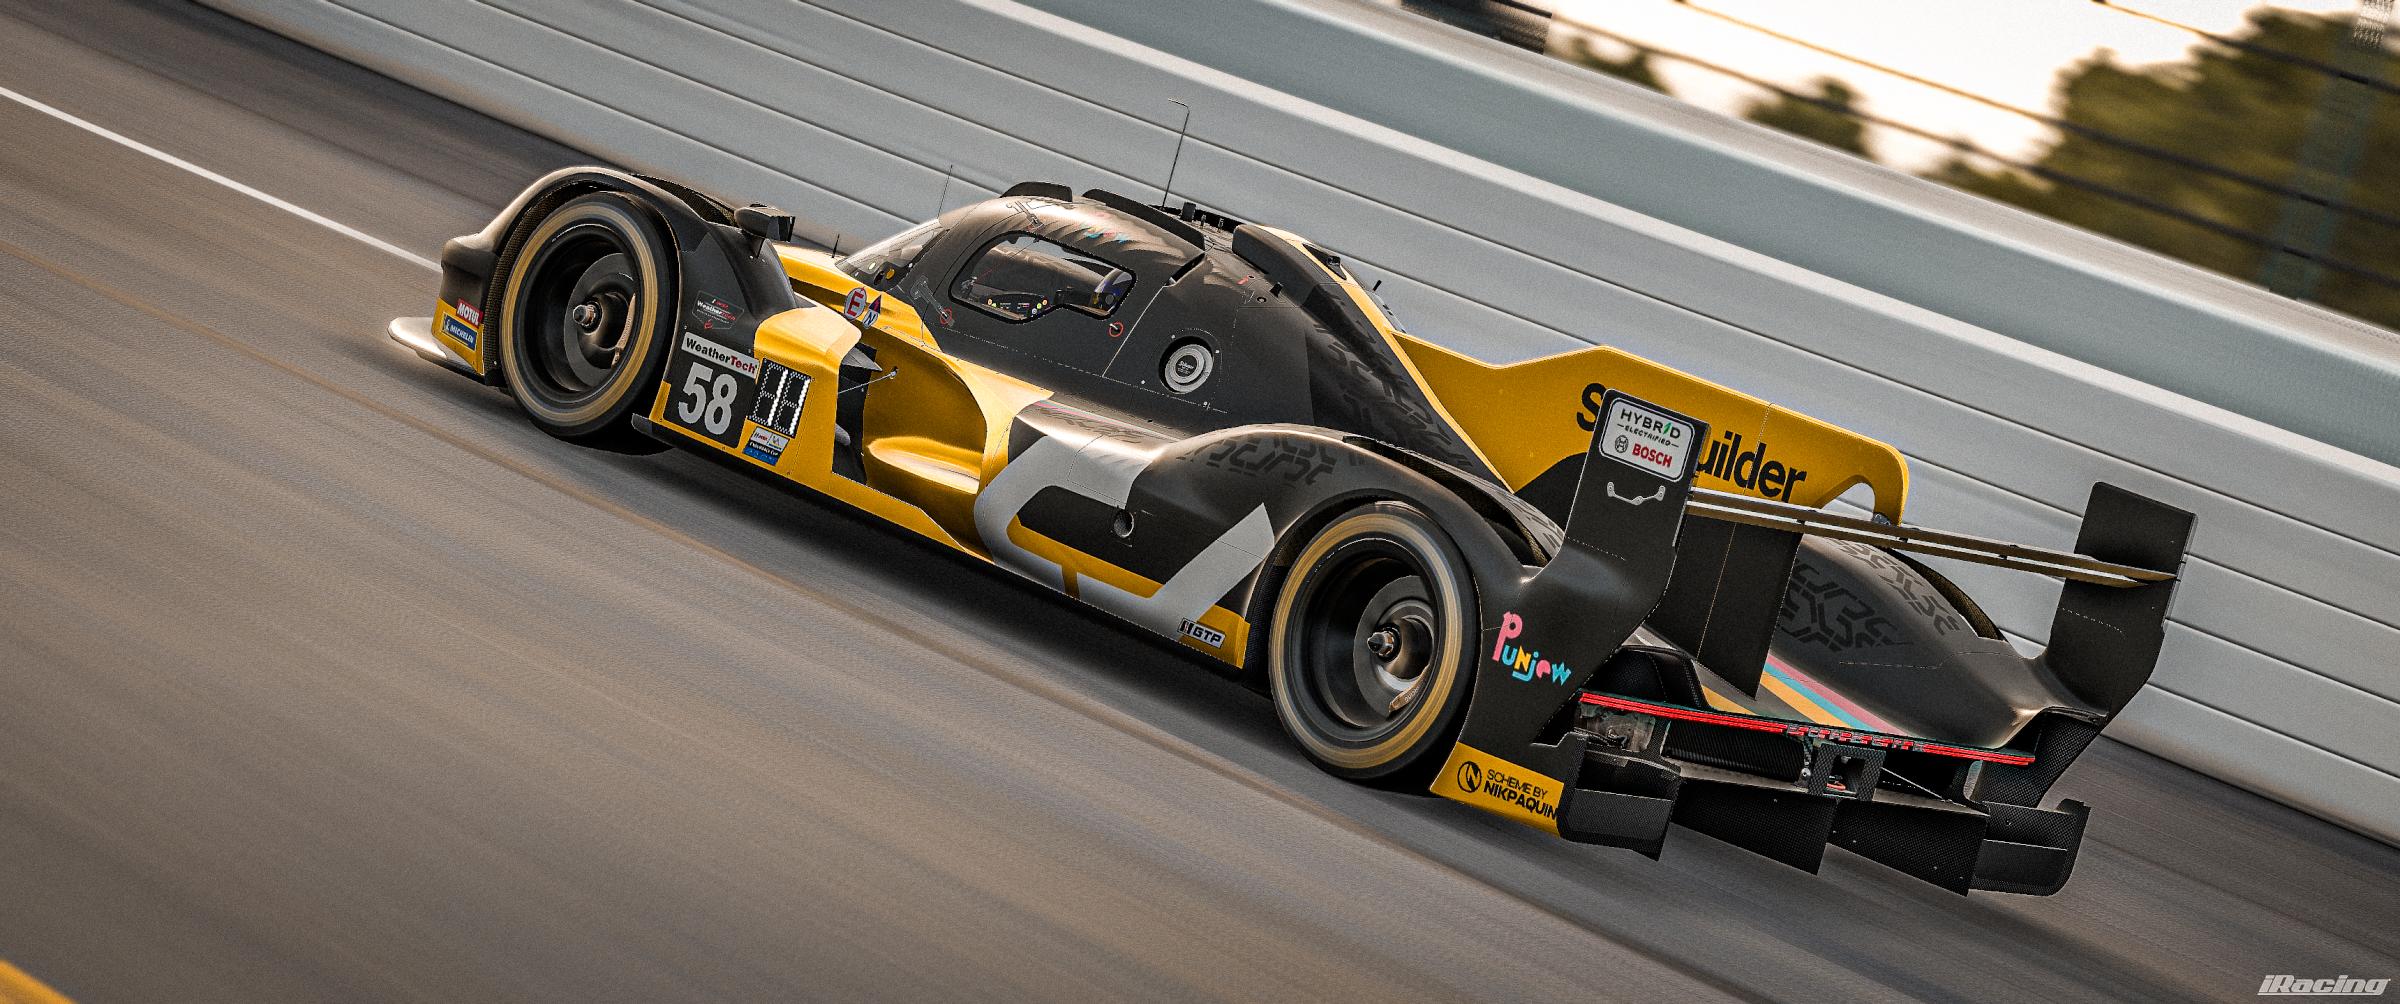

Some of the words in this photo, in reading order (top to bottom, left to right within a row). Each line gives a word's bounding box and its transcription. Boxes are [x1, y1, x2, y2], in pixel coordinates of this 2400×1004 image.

[457, 302, 480, 326] MOTUL
[847, 290, 864, 317] E
[685, 337, 757, 374] WeatherTech
[678, 361, 738, 435] 58
[1620, 408, 1681, 439] HYBRID
[1624, 425, 1671, 447] ELECTRIFIED
[1632, 442, 1673, 468] BOSCH
[1193, 626, 1222, 643] GTP
[1487, 769, 1532, 794] SCHEME
[1533, 786, 1548, 799] BY
